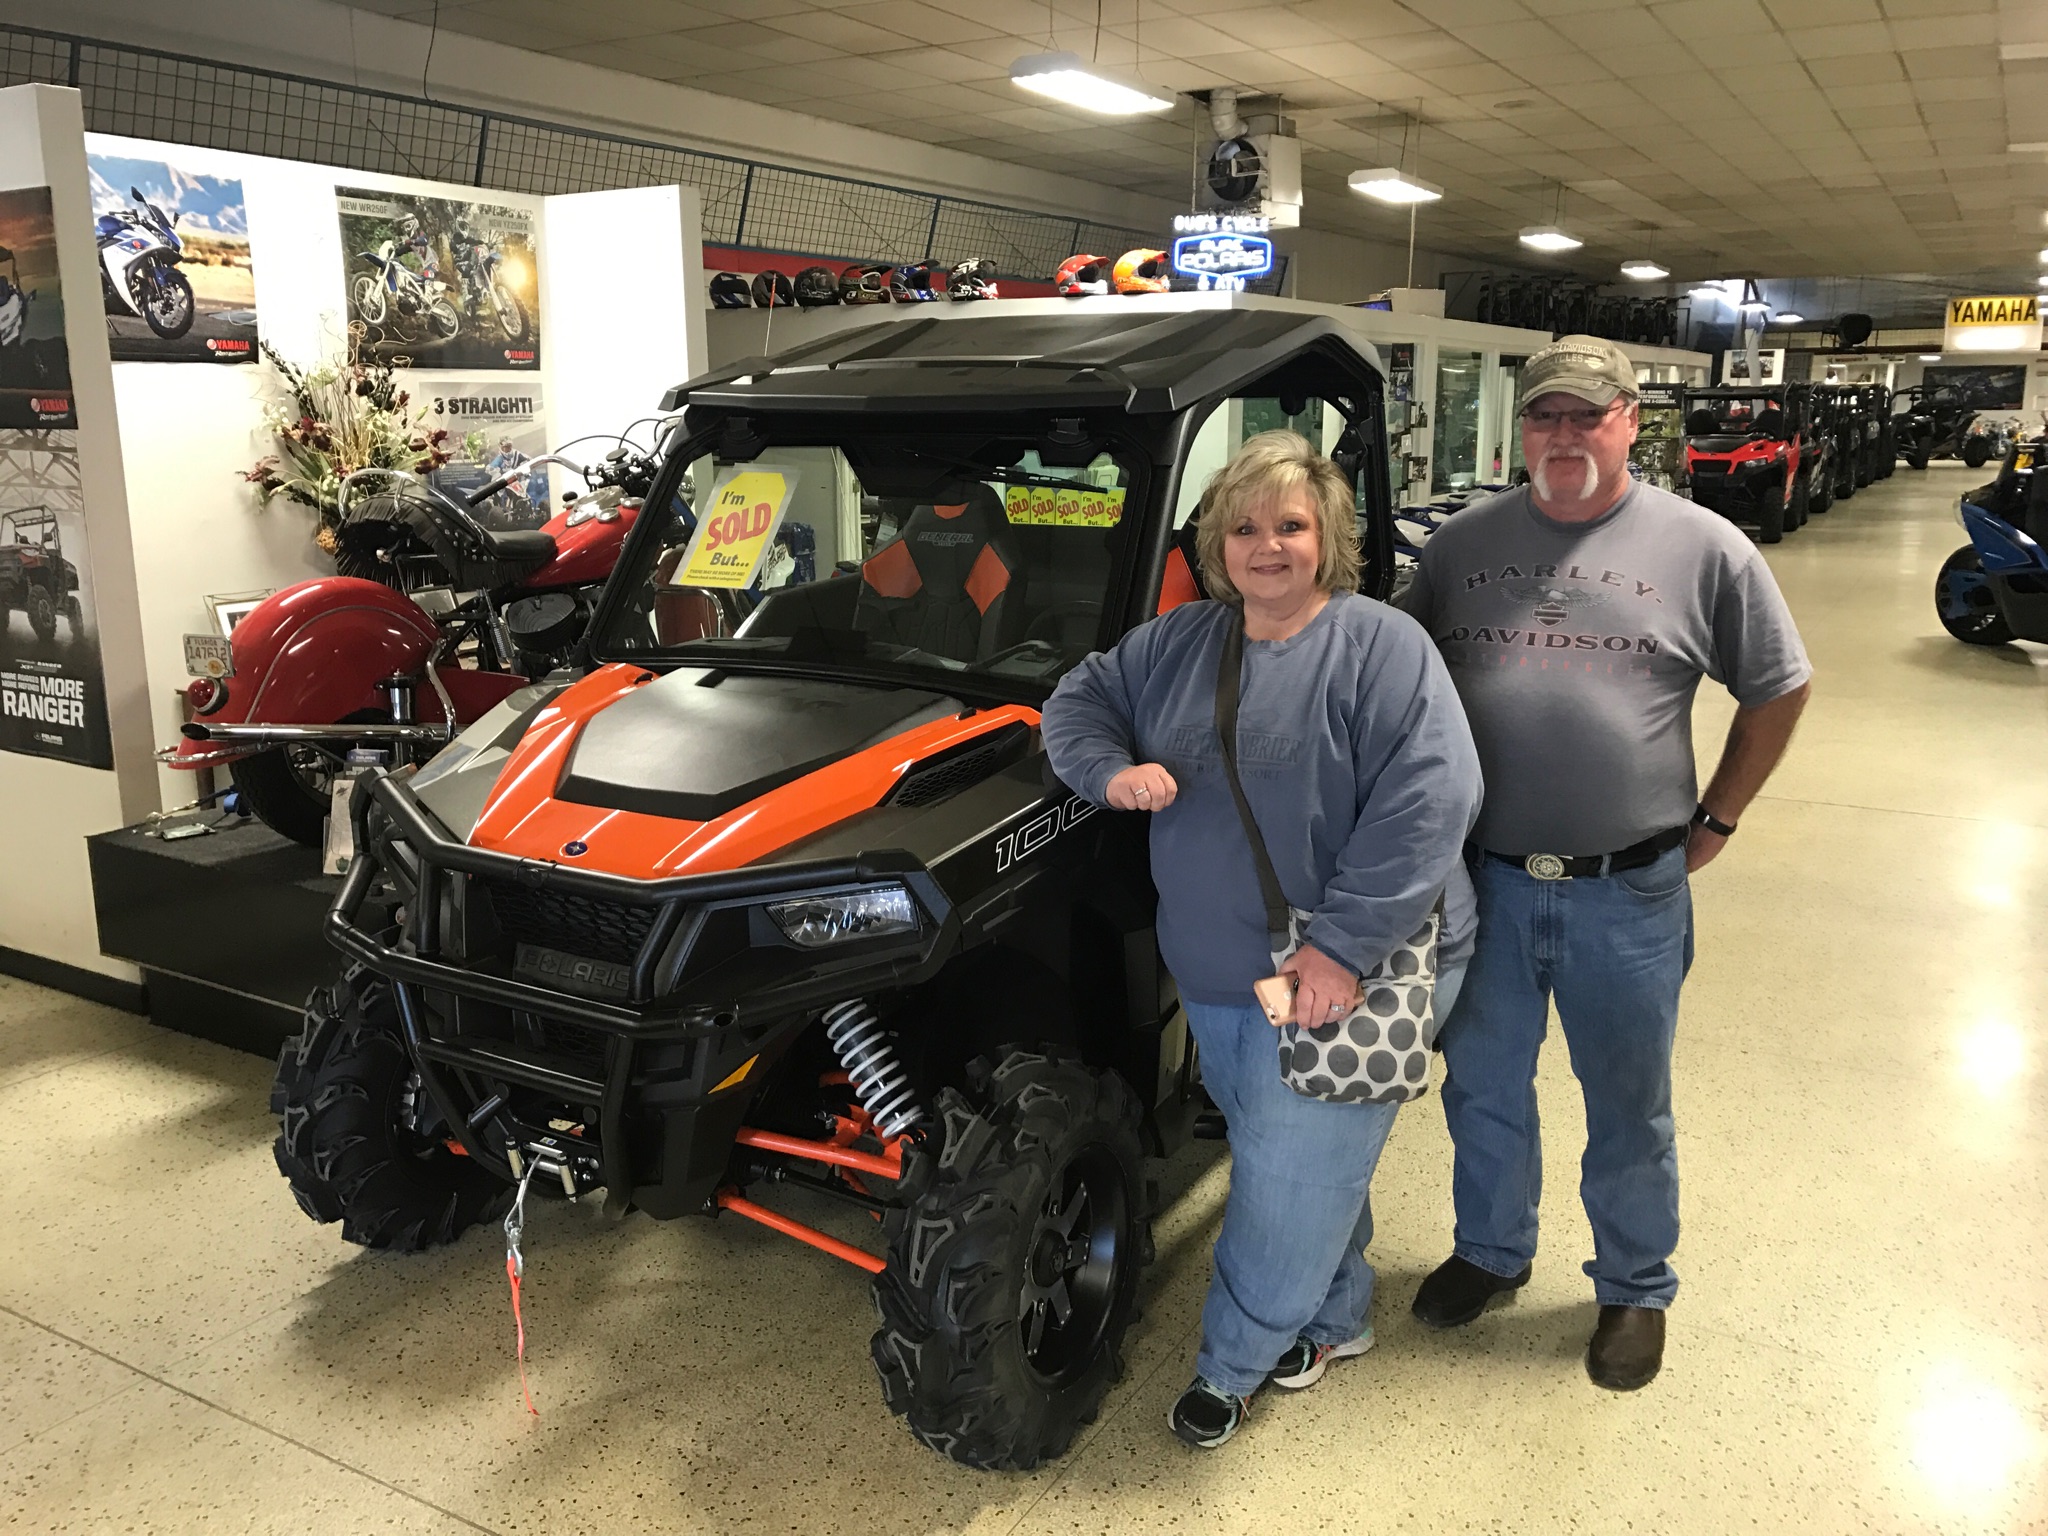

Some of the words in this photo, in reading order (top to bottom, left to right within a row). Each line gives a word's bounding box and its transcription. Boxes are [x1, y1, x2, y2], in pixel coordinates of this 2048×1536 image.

[340, 200, 358, 211] NEW
[359, 202, 388, 214] WR250F
[488, 218, 502, 228] NEW
[1221, 215, 1270, 232] CYCLE
[1180, 250, 1265, 268] POLARIS
[1197, 274, 1210, 291] &
[1215, 275, 1245, 291] ATV
[1953, 300, 2037, 323] YAMAHA
[216, 340, 251, 351] YAMAHA
[510, 351, 535, 360] YAMAHA
[40, 398, 69, 412] YAMAHA
[434, 397, 445, 415] 3
[722, 491, 745, 506] I'm
[1007, 498, 1029, 517] SOLD
[1032, 499, 1054, 518] SOLD
[1057, 500, 1080, 519] SOLD
[1082, 501, 1105, 520] SOLD
[706, 502, 772, 551] SOLD
[917, 531, 974, 543] GENERAL
[709, 552, 750, 568] But...
[1451, 626, 1660, 655] DAVIDSON
[188, 646, 228, 660] 147612
[40, 676, 84, 700] MORE
[2, 690, 85, 728] RANGER
[1165, 727, 1194, 752] THE
[521, 949, 630, 991] POLARIS
